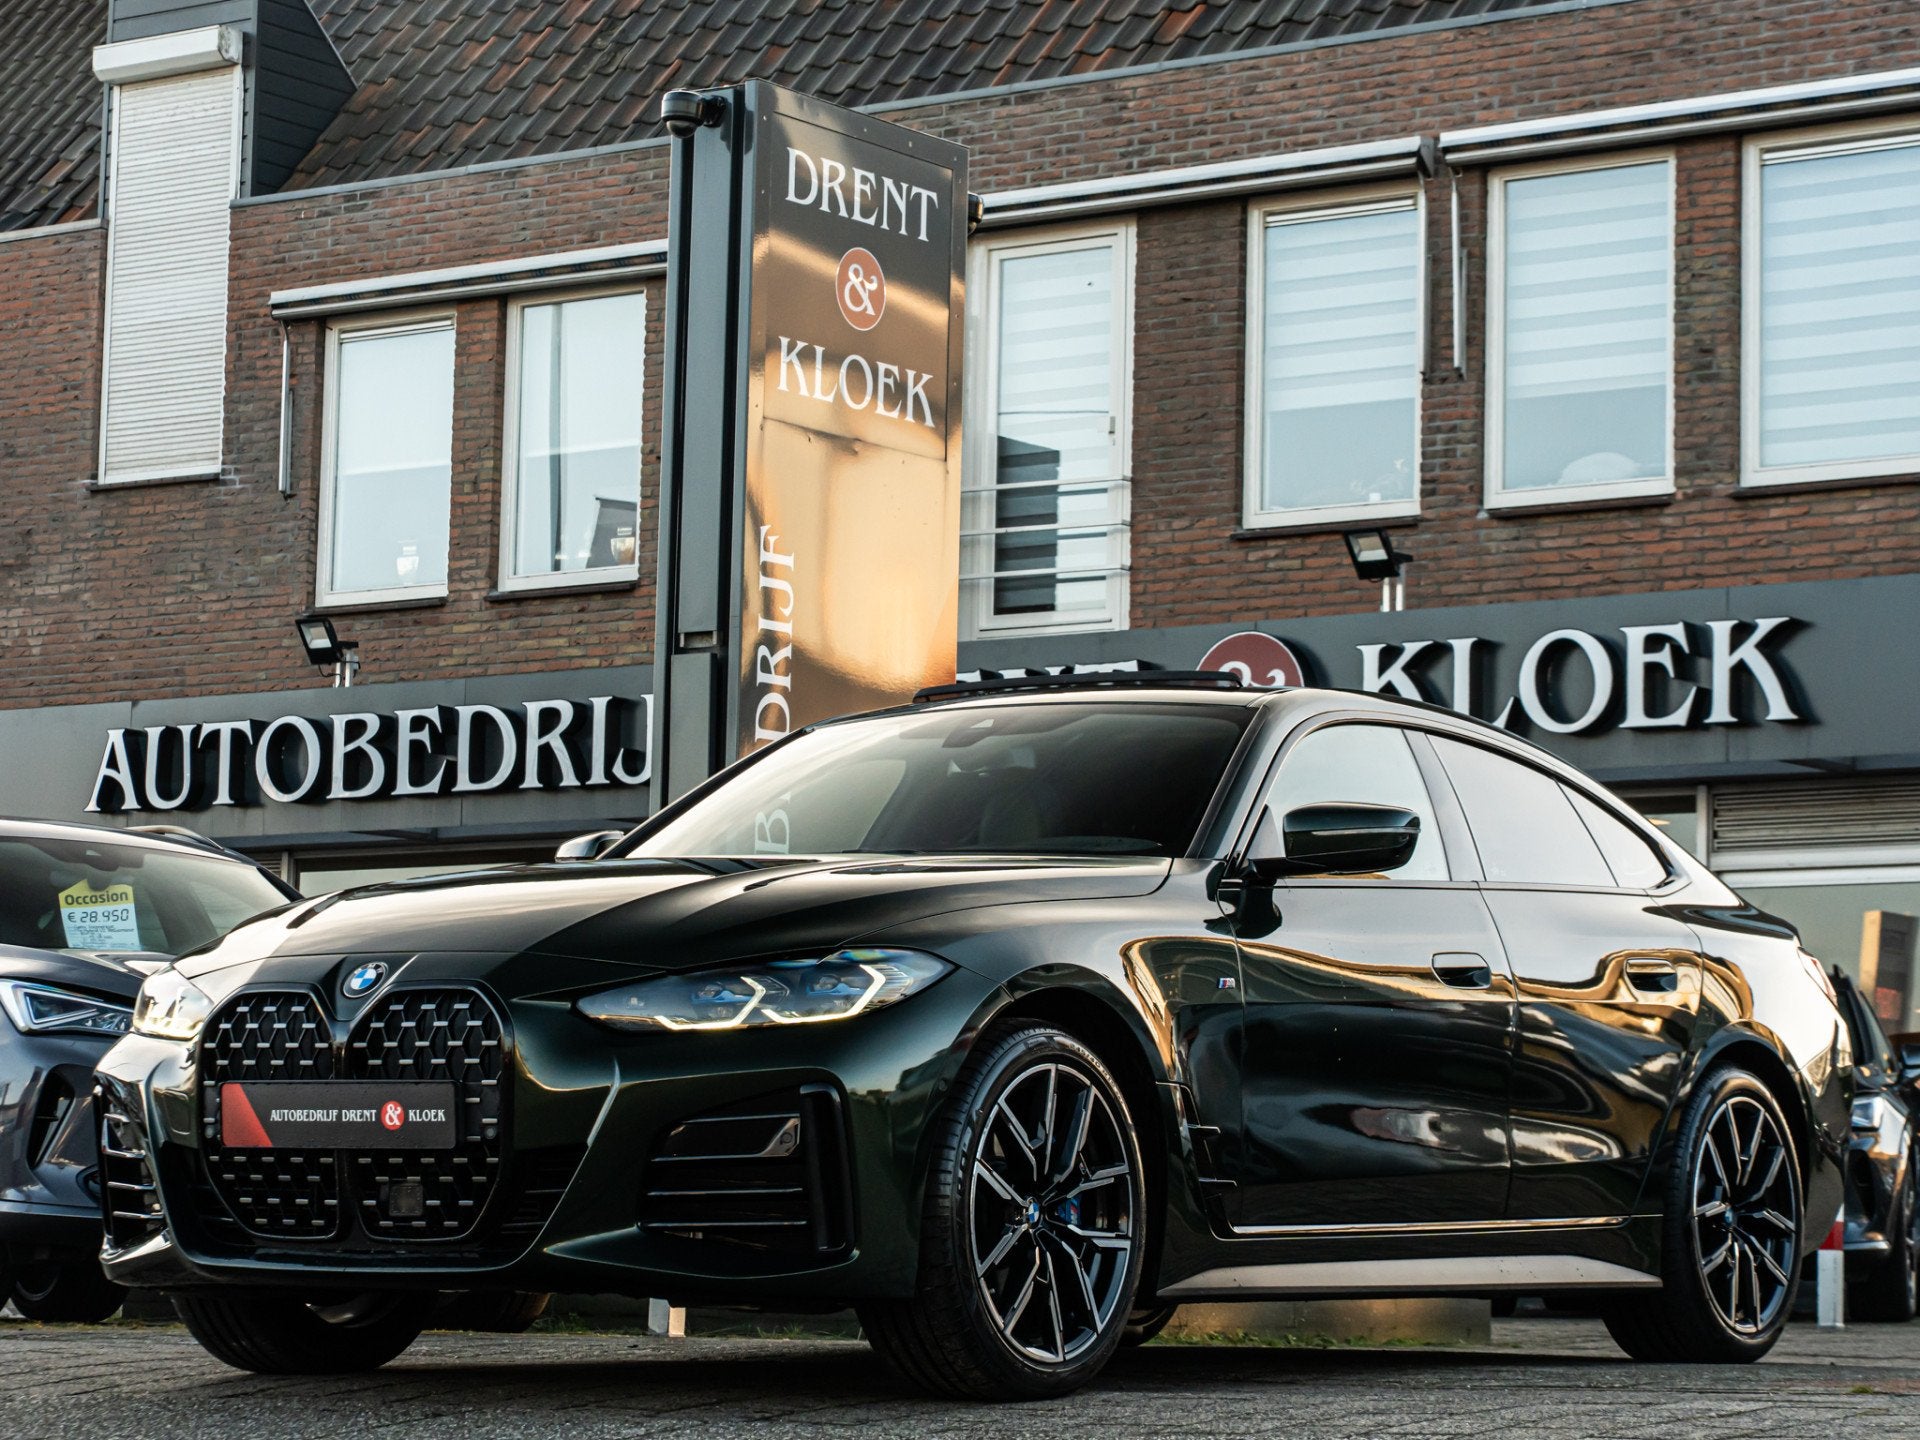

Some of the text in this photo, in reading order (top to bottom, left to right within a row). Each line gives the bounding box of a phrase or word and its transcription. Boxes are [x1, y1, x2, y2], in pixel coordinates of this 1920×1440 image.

[785, 147, 939, 242] DRENT
[844, 263, 878, 316] &
[777, 336, 935, 428] KLOEK
[753, 524, 795, 854] BDRIJF
[1355, 616, 1800, 734] KLOEK
[64, 891, 128, 905] Occasion
[270, 1103, 446, 1126] AUTOBEDRIJF DRENT & KLOEK
